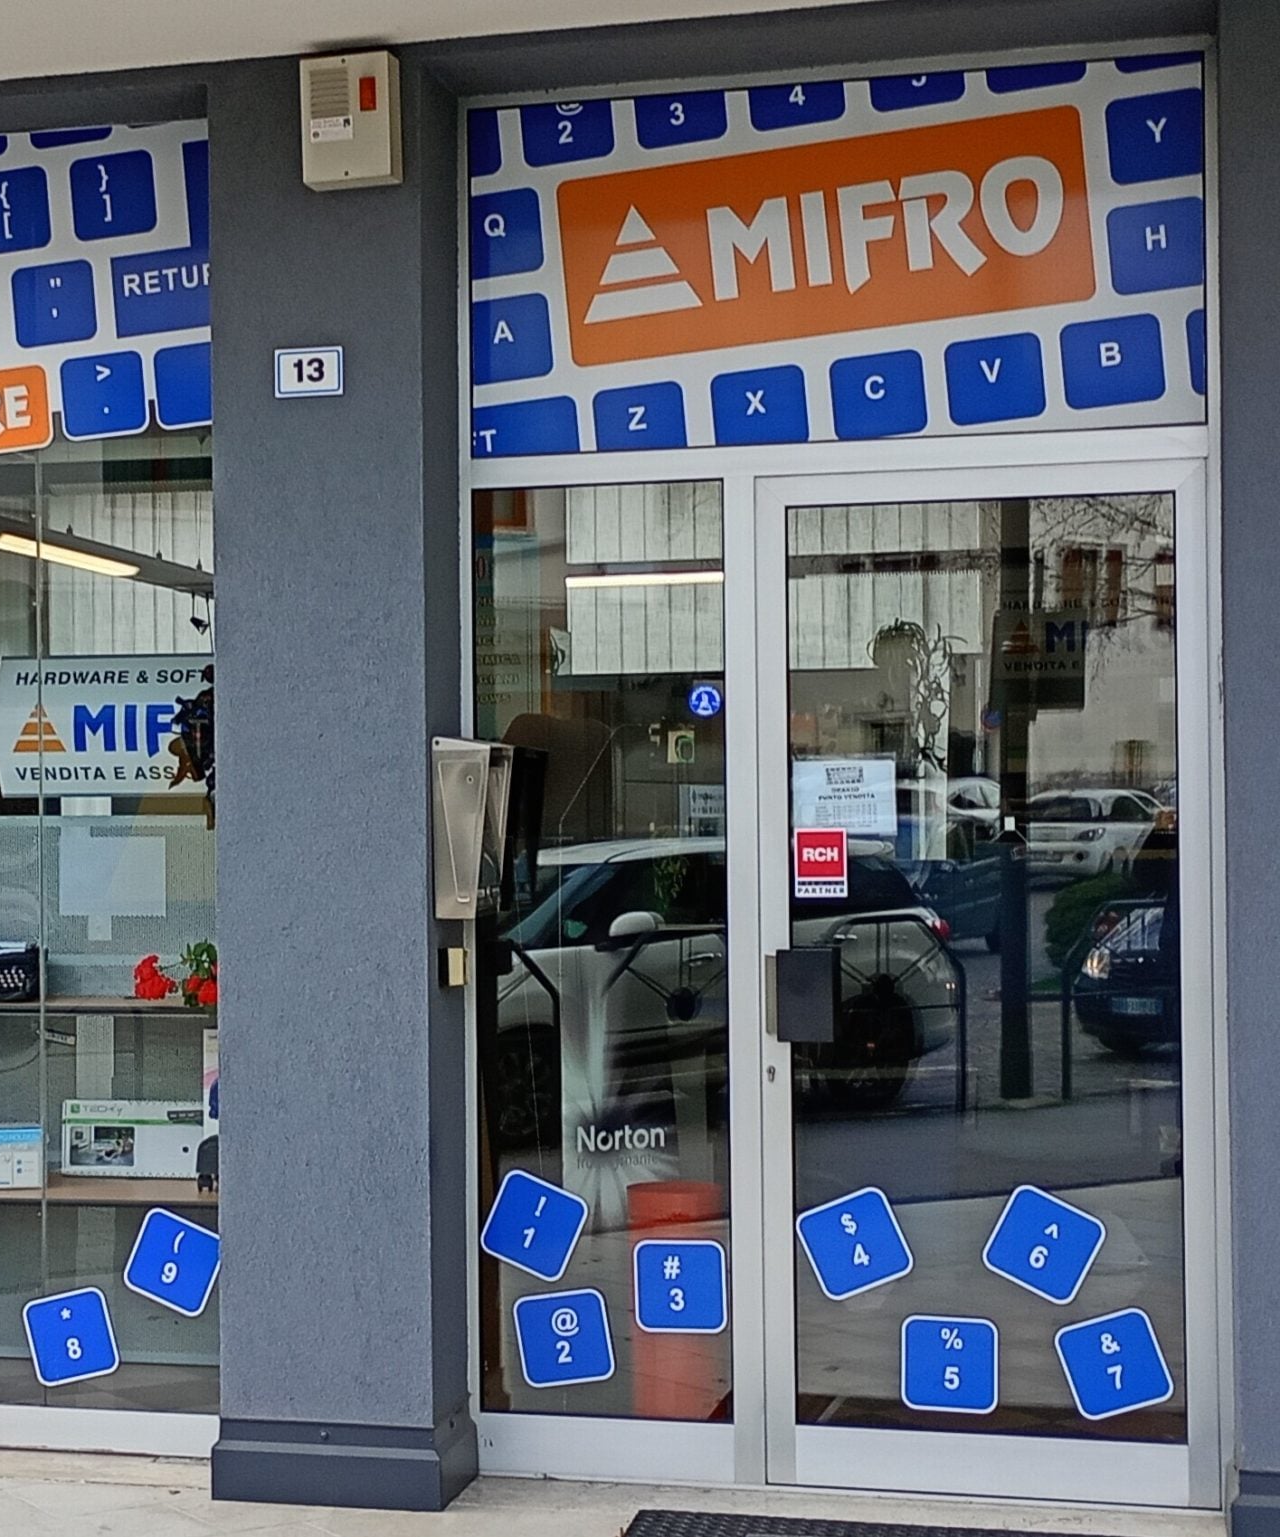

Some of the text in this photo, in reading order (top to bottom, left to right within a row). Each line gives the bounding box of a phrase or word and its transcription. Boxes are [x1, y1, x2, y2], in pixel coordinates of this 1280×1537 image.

[789, 85, 805, 105] 4
[669, 103, 685, 126] 3
[557, 121, 573, 144] 2
[1147, 117, 1167, 143] Y
[484, 213, 506, 237] Q
[706, 155, 1064, 302] MIFRO
[1146, 225, 1166, 251] H
[494, 321, 514, 344] A
[1100, 342, 1121, 368] B
[293, 358, 325, 383] 13
[980, 357, 1002, 383] V
[864, 375, 885, 400] C
[745, 390, 766, 416] X
[628, 406, 647, 431] Z
[473, 429, 497, 452] T
[16, 670, 129, 686] HARDWARE
[136, 670, 149, 684] &
[73, 705, 175, 758] MIF
[15, 766, 105, 781] VENDITA
[115, 767, 127, 780] E
[802, 847, 839, 862] RCH
[577, 1124, 667, 1153] Norton
[840, 1213, 857, 1236] $
[523, 1227, 536, 1248] 1
[853, 1243, 870, 1267] 4
[1028, 1245, 1049, 1269] 6
[161, 1262, 177, 1284] 9
[663, 1255, 681, 1280] #
[669, 1288, 685, 1312] 3
[551, 1308, 580, 1336] @
[66, 1337, 81, 1360] 8
[941, 1328, 963, 1350] %
[1100, 1333, 1121, 1355] &
[556, 1341, 573, 1364] 2
[943, 1366, 960, 1391] 5
[1107, 1364, 1124, 1390] 7
